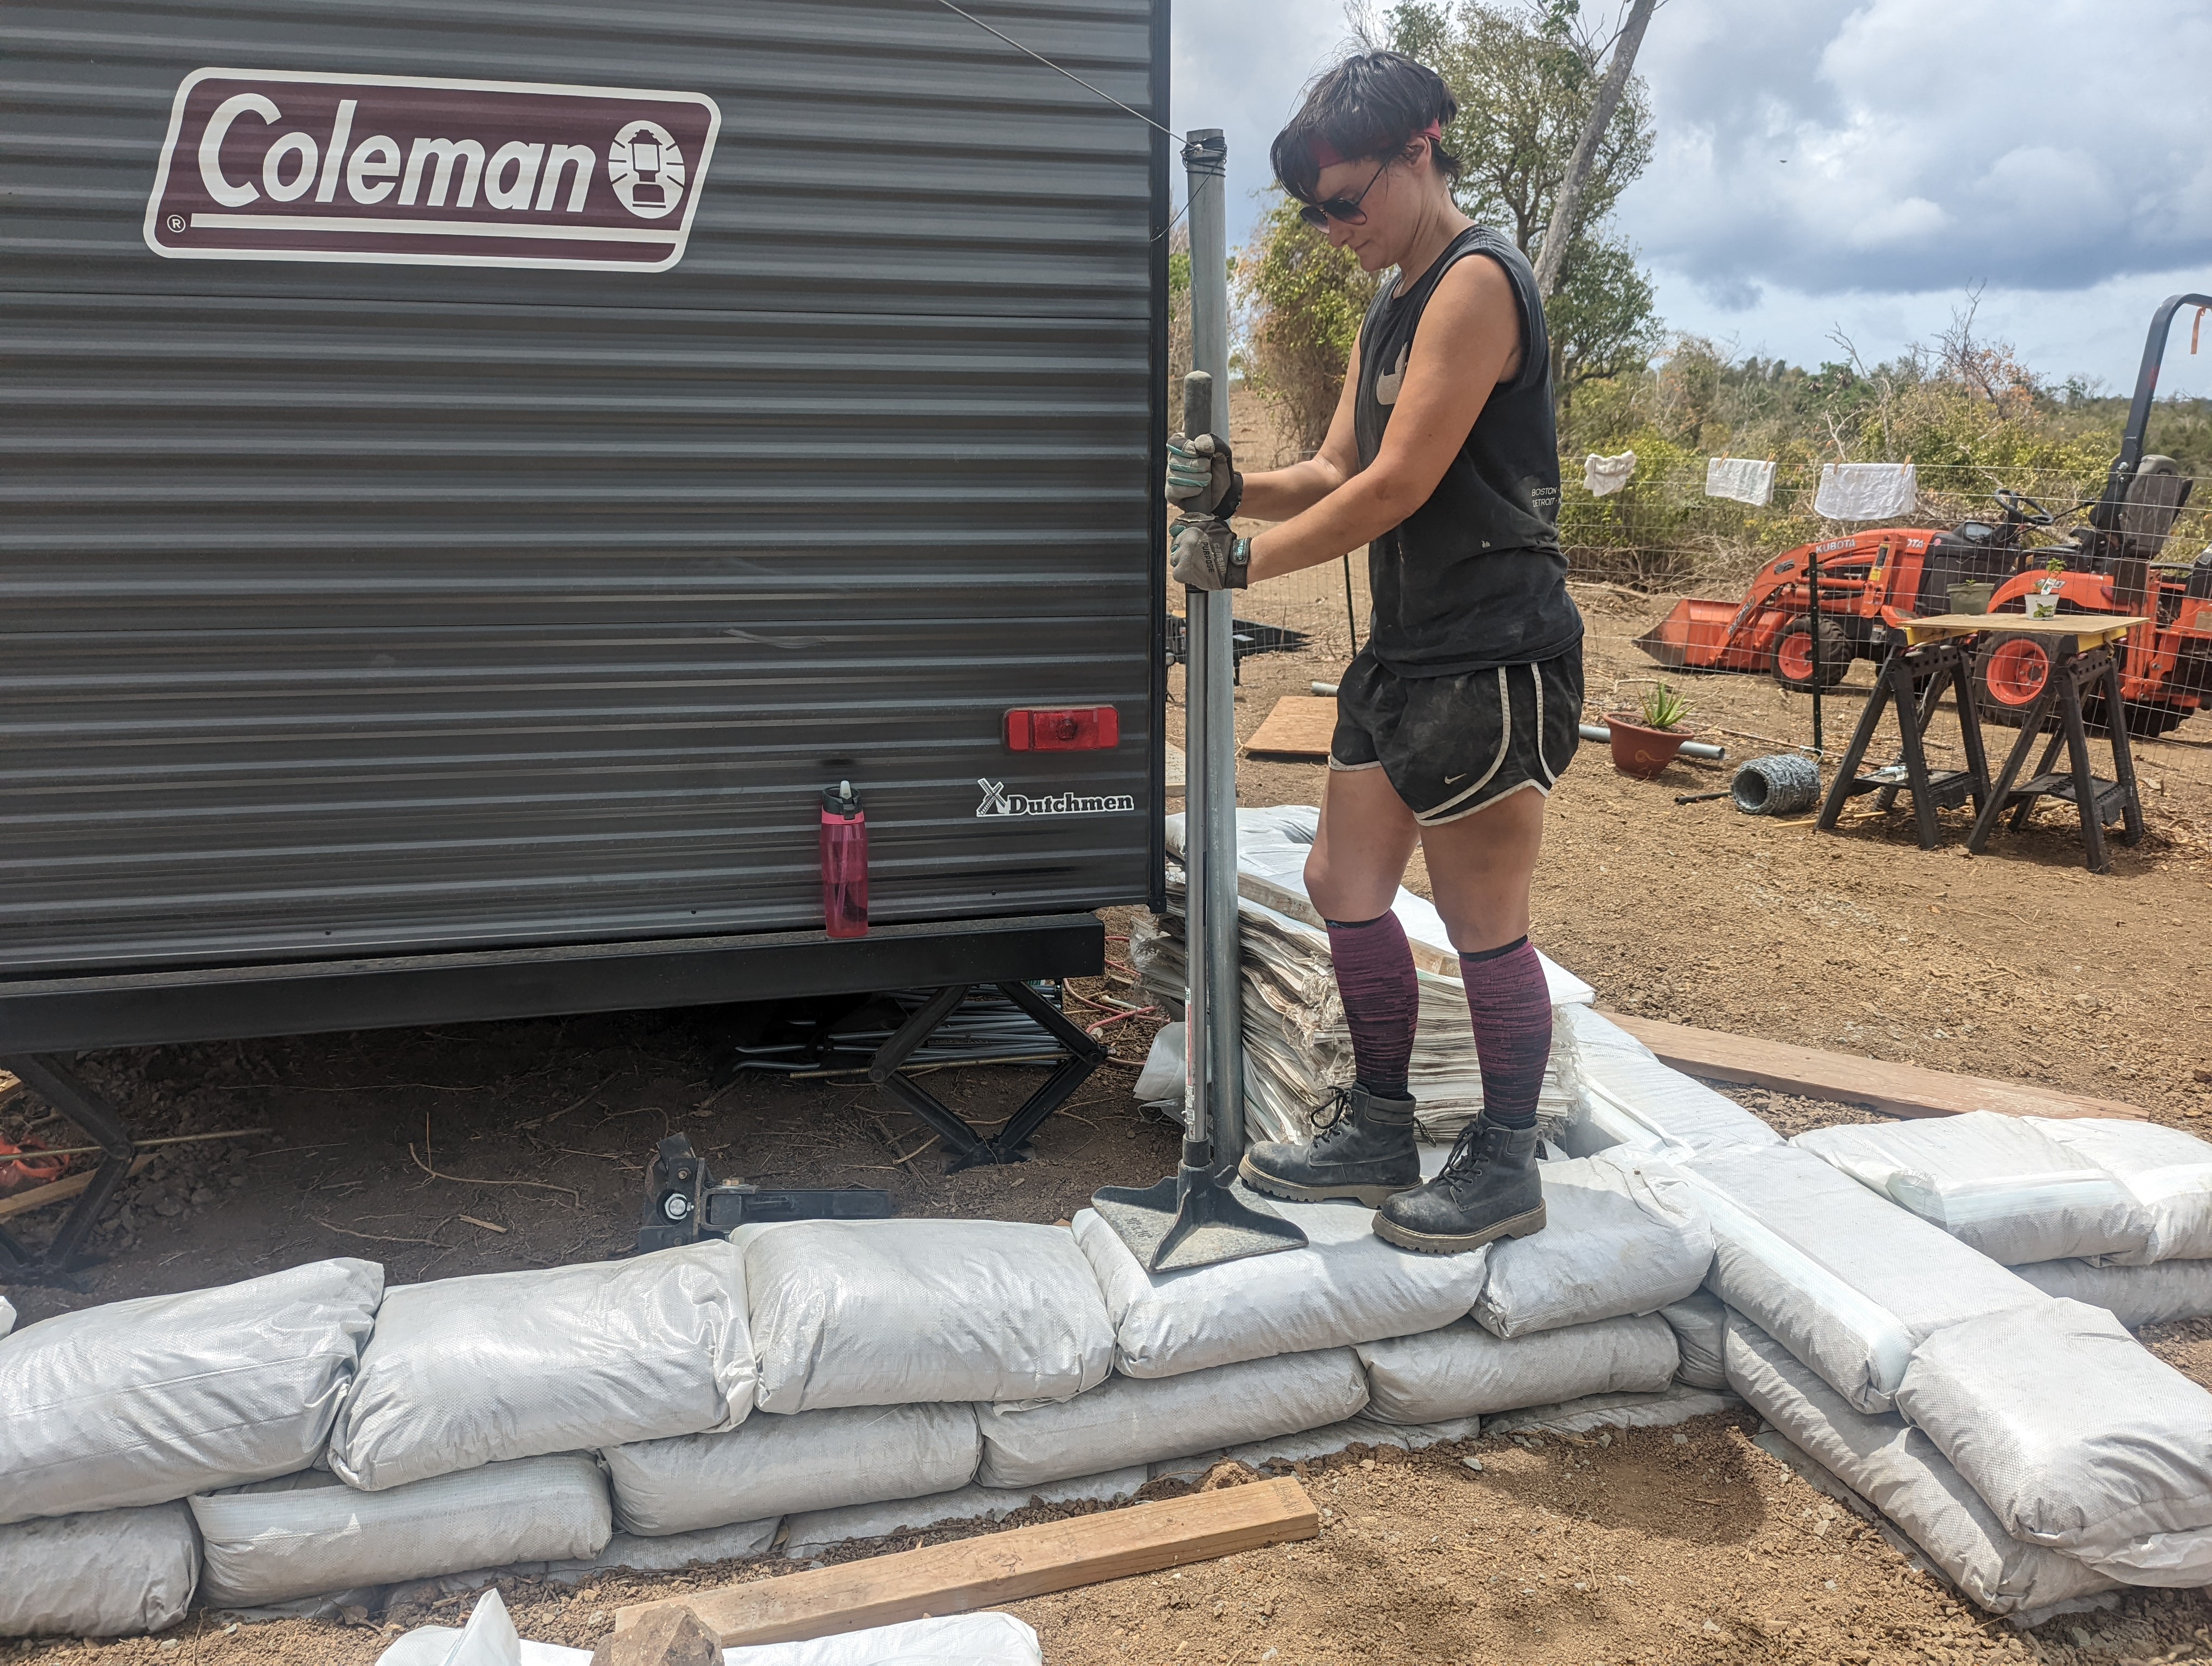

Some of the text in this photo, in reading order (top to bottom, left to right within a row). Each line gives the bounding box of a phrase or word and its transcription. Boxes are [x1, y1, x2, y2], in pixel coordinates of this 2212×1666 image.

[198, 93, 596, 213] Coleman
[1532, 487, 1557, 496] BOSTON
[1532, 497, 1555, 507] DETROIT
[1816, 539, 1855, 553] KUBOTA
[1906, 538, 1924, 548] OTA
[1203, 542, 1215, 573] PURPOSE
[1213, 543, 1226, 575] GENERAL
[1009, 793, 1133, 813] Dutchmen
